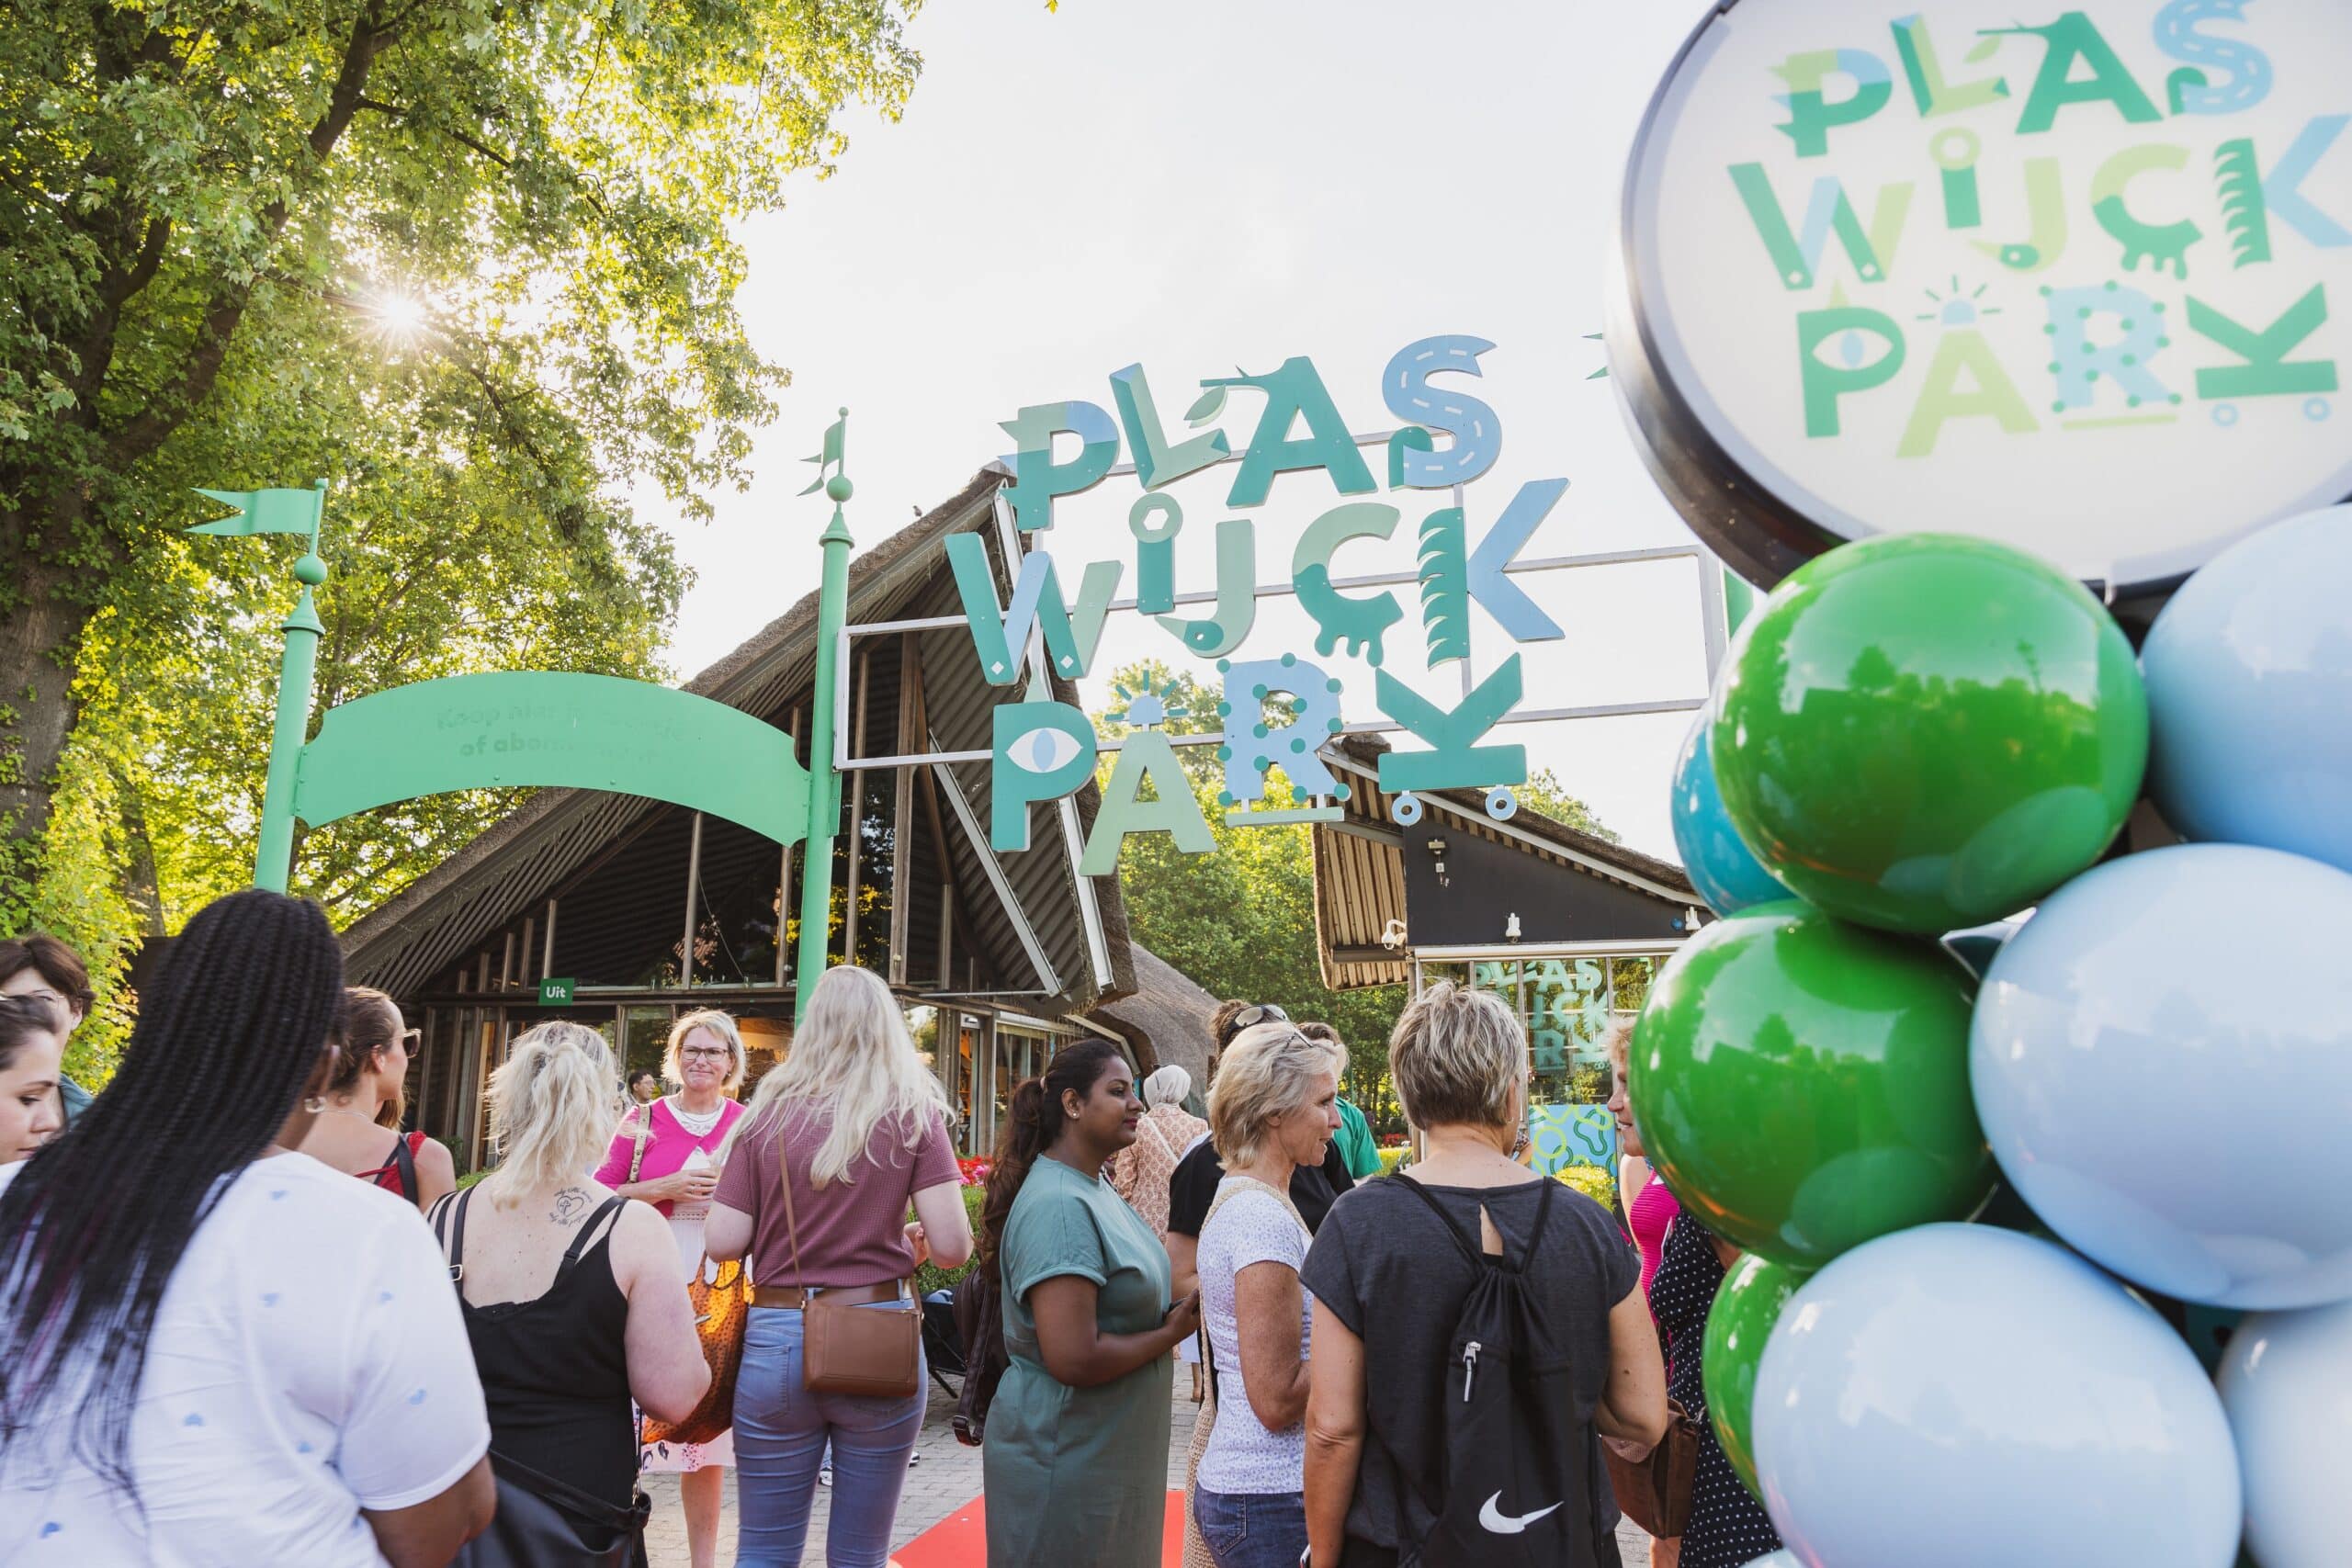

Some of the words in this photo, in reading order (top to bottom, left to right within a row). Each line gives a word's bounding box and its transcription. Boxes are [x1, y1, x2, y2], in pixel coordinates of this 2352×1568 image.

[1769, 0, 2274, 158] PLAS
[998, 334, 1502, 531] PLAS
[1796, 278, 2338, 458] PARK
[460, 735, 487, 756] of
[991, 653, 1527, 876] PARK
[546, 986, 566, 998] Uit
